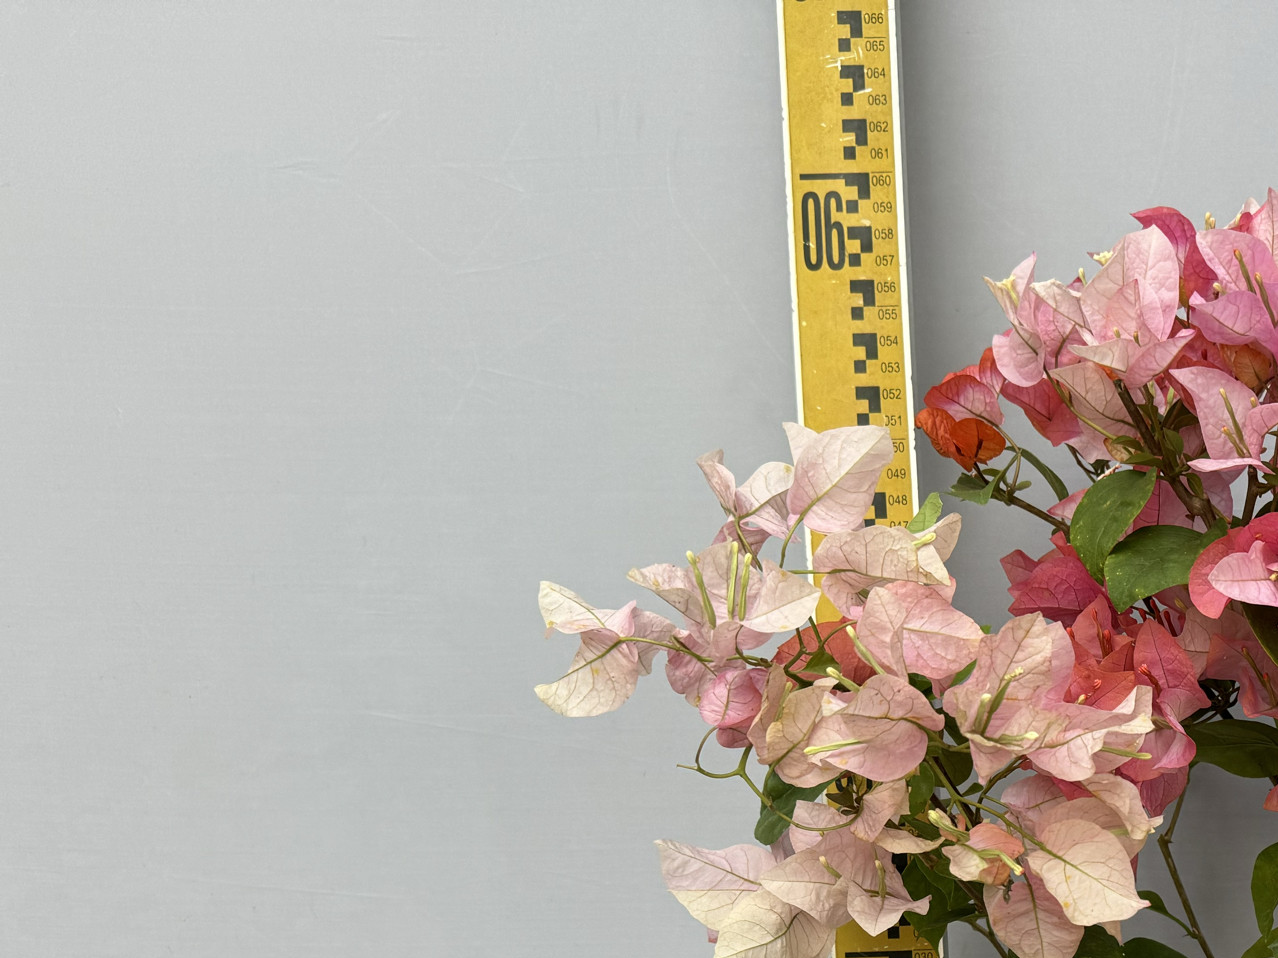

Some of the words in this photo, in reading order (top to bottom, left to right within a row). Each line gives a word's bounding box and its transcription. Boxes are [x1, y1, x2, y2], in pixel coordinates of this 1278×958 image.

[863, 13, 884, 24] 066
[865, 40, 885, 52] 065
[866, 68, 886, 79] 064
[867, 94, 887, 105] 063
[869, 121, 889, 132] 062
[870, 148, 889, 159] 061
[871, 175, 891, 186] 060
[872, 202, 893, 213] 059
[801, 191, 846, 271] 06
[874, 229, 894, 240] 058
[875, 255, 895, 266] 057
[876, 282, 896, 293] 056
[877, 309, 898, 320] 055
[879, 336, 898, 347] 054
[880, 362, 900, 373] 053
[882, 389, 902, 400] 052
[893, 442, 905, 453] 50
[887, 468, 906, 479] 049
[888, 495, 908, 506] 048
